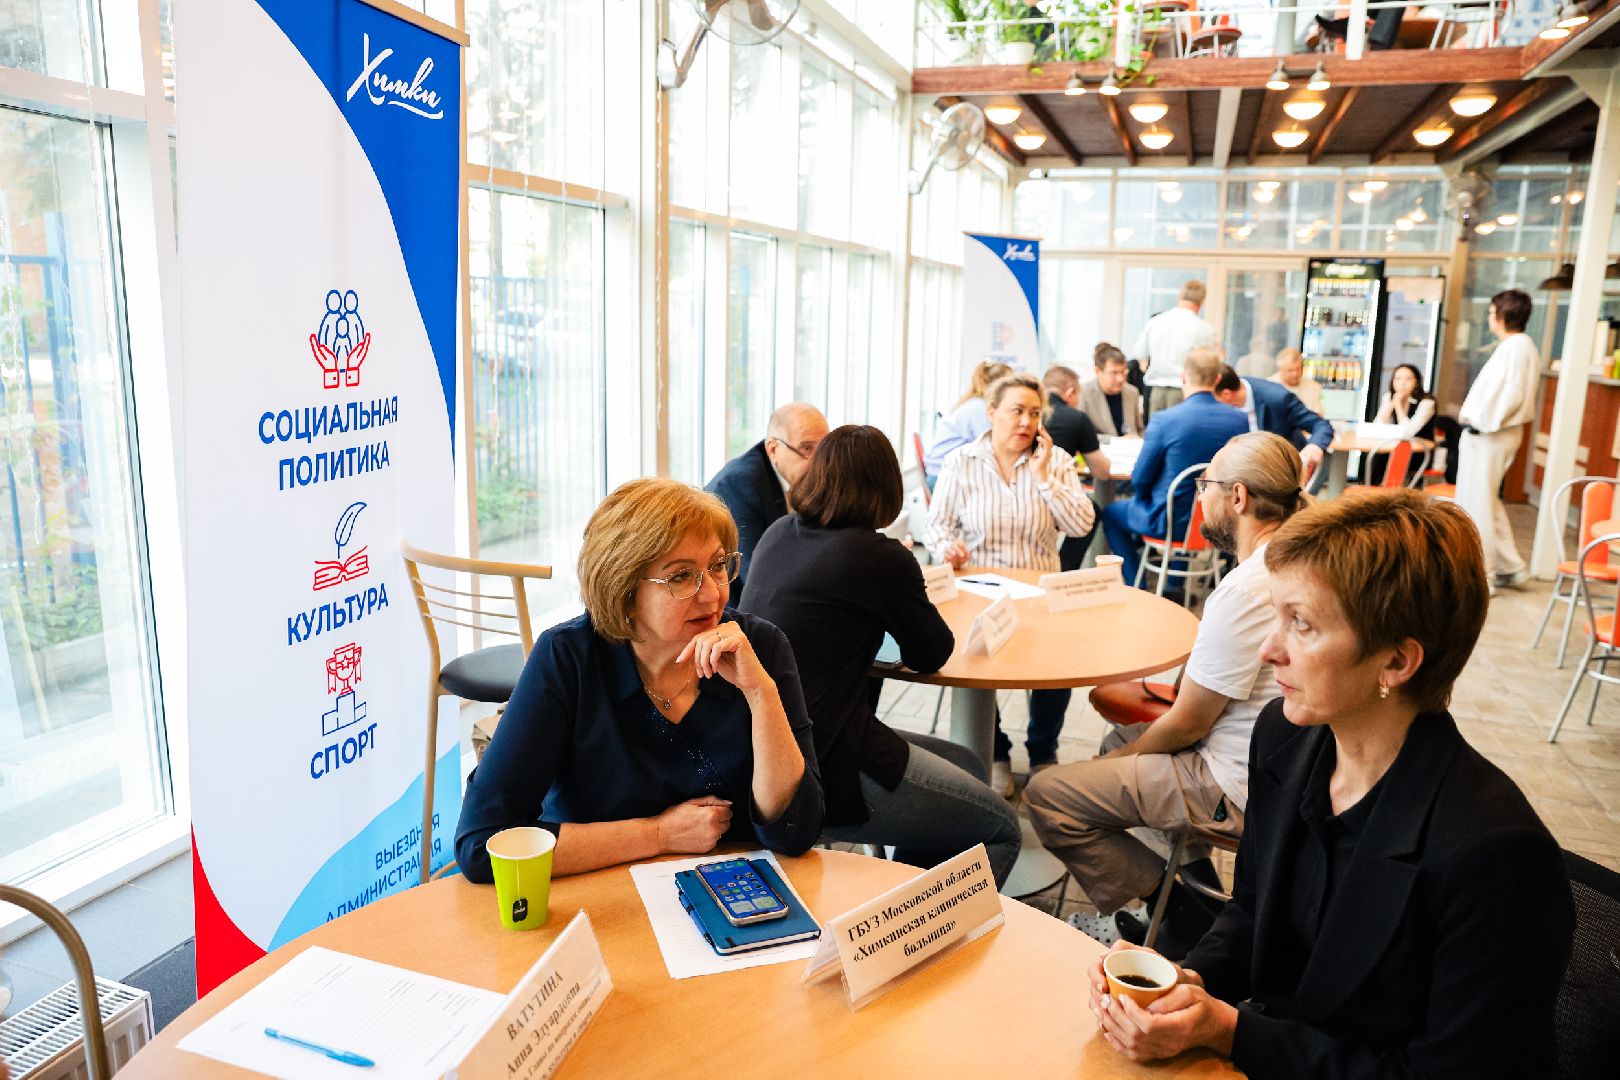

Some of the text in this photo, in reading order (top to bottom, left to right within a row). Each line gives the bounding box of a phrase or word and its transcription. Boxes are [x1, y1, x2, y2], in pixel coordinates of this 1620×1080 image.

[346, 32, 443, 119] Химки
[258, 395, 398, 444] СОЦИАЛЬНАЯ
[279, 440, 390, 491] ПОЛИТИКА
[287, 582, 389, 646] КУЛЬТУРА
[310, 722, 378, 779] СПОРТ
[375, 813, 440, 871] ВЫЕЗДНЯ
[847, 861, 982, 942] ГБУЗ Московской области
[853, 878, 989, 963] «Химкинская клиническая
[903, 920, 956, 957] больница»
[506, 971, 564, 1041] ВАТУТИНА
[507, 982, 581, 1079] Анна Эдуардовна
